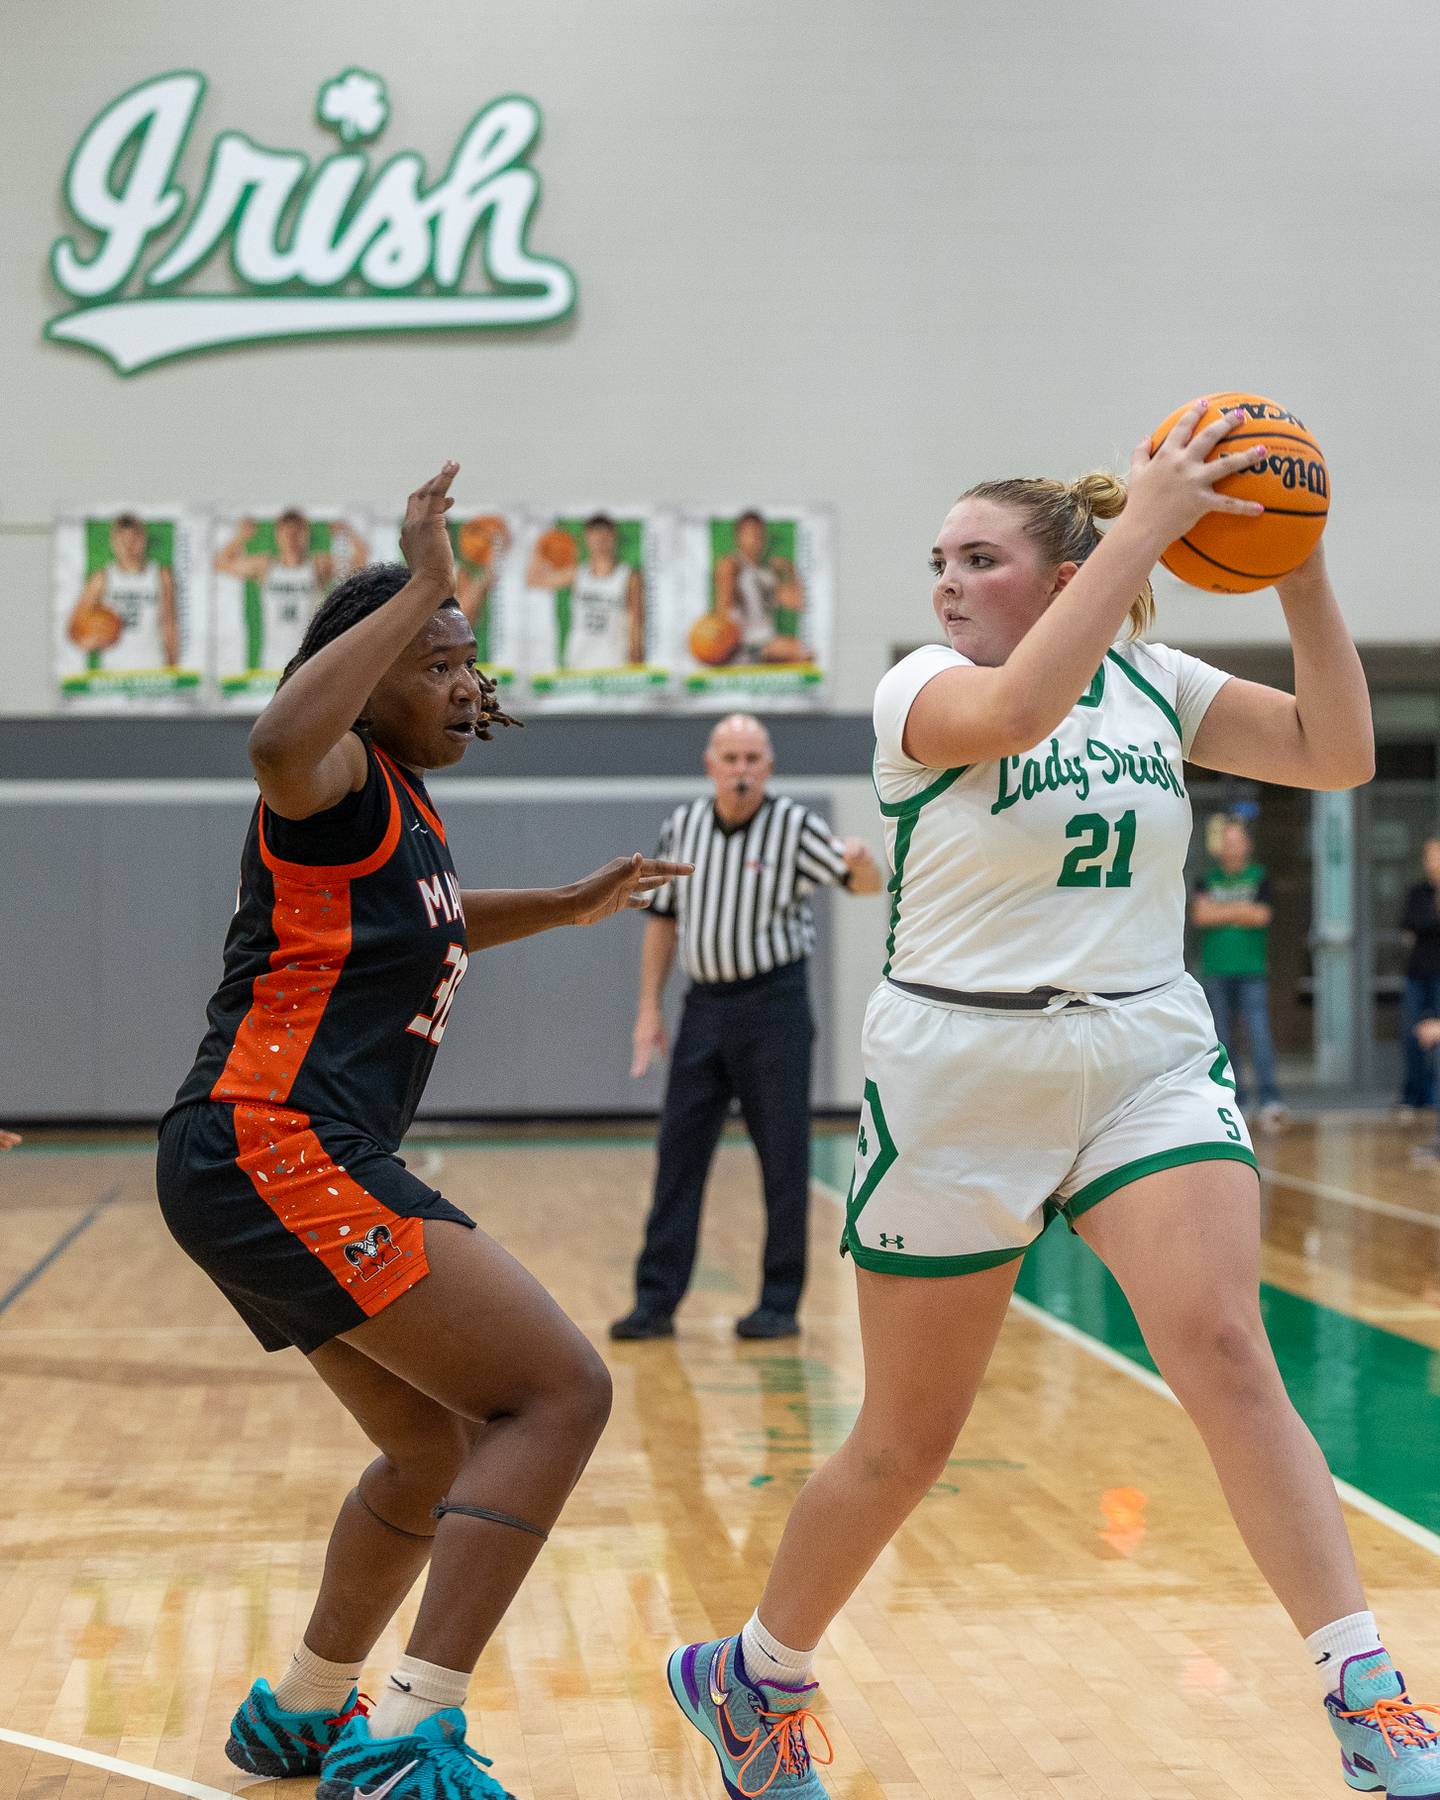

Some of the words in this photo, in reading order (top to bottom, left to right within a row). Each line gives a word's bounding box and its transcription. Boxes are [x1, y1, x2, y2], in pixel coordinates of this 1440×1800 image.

[49, 66, 577, 308] Irish
[1220, 454, 1328, 499] Wilso
[991, 738, 1090, 815] Lady
[1087, 738, 1185, 798] Irish
[1056, 809, 1137, 888] 21
[1217, 1107, 1241, 1141] S
